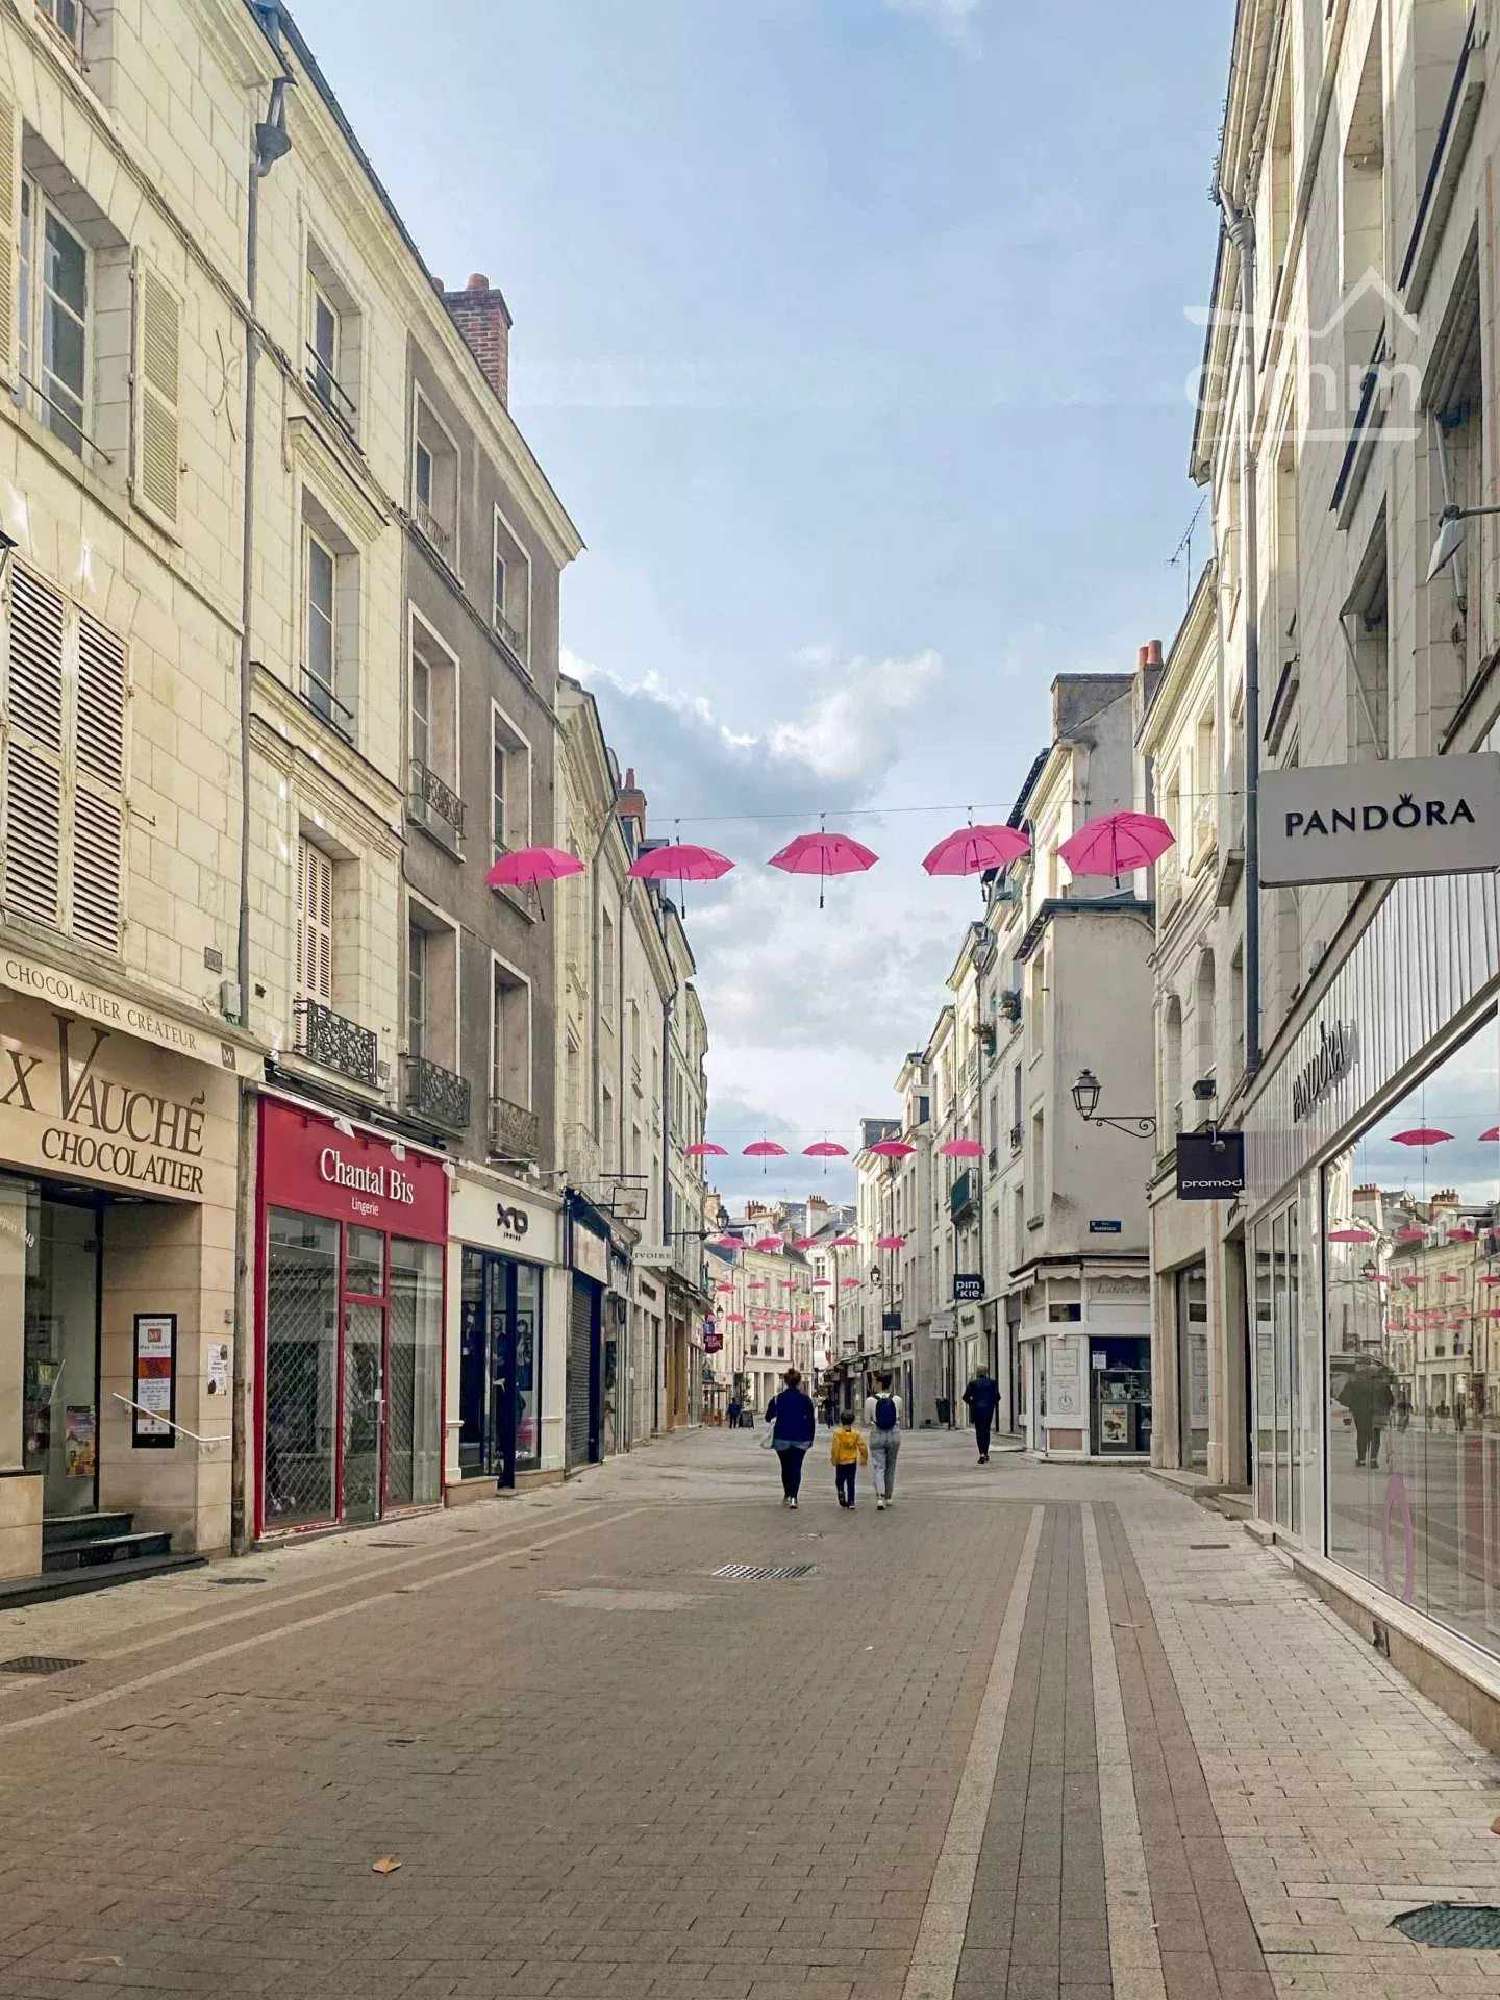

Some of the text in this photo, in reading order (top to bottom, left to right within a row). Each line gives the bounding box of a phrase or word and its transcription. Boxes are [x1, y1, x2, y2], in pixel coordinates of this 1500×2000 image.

[1285, 793, 1475, 836] PANDORA
[5, 959, 197, 1051] CHOCOLATIER CRÉATEUR
[53, 1013, 206, 1157] VAUCHÉ
[1293, 1020, 1346, 1124] PANDORA
[41, 1128, 204, 1194] CHOCOLATIER
[320, 1147, 414, 1205] Chantal Bis
[1181, 1179, 1243, 1190] promod
[351, 1197, 379, 1217] Lingerie
[955, 1280, 980, 1292] pim
[960, 1289, 980, 1298] kie
